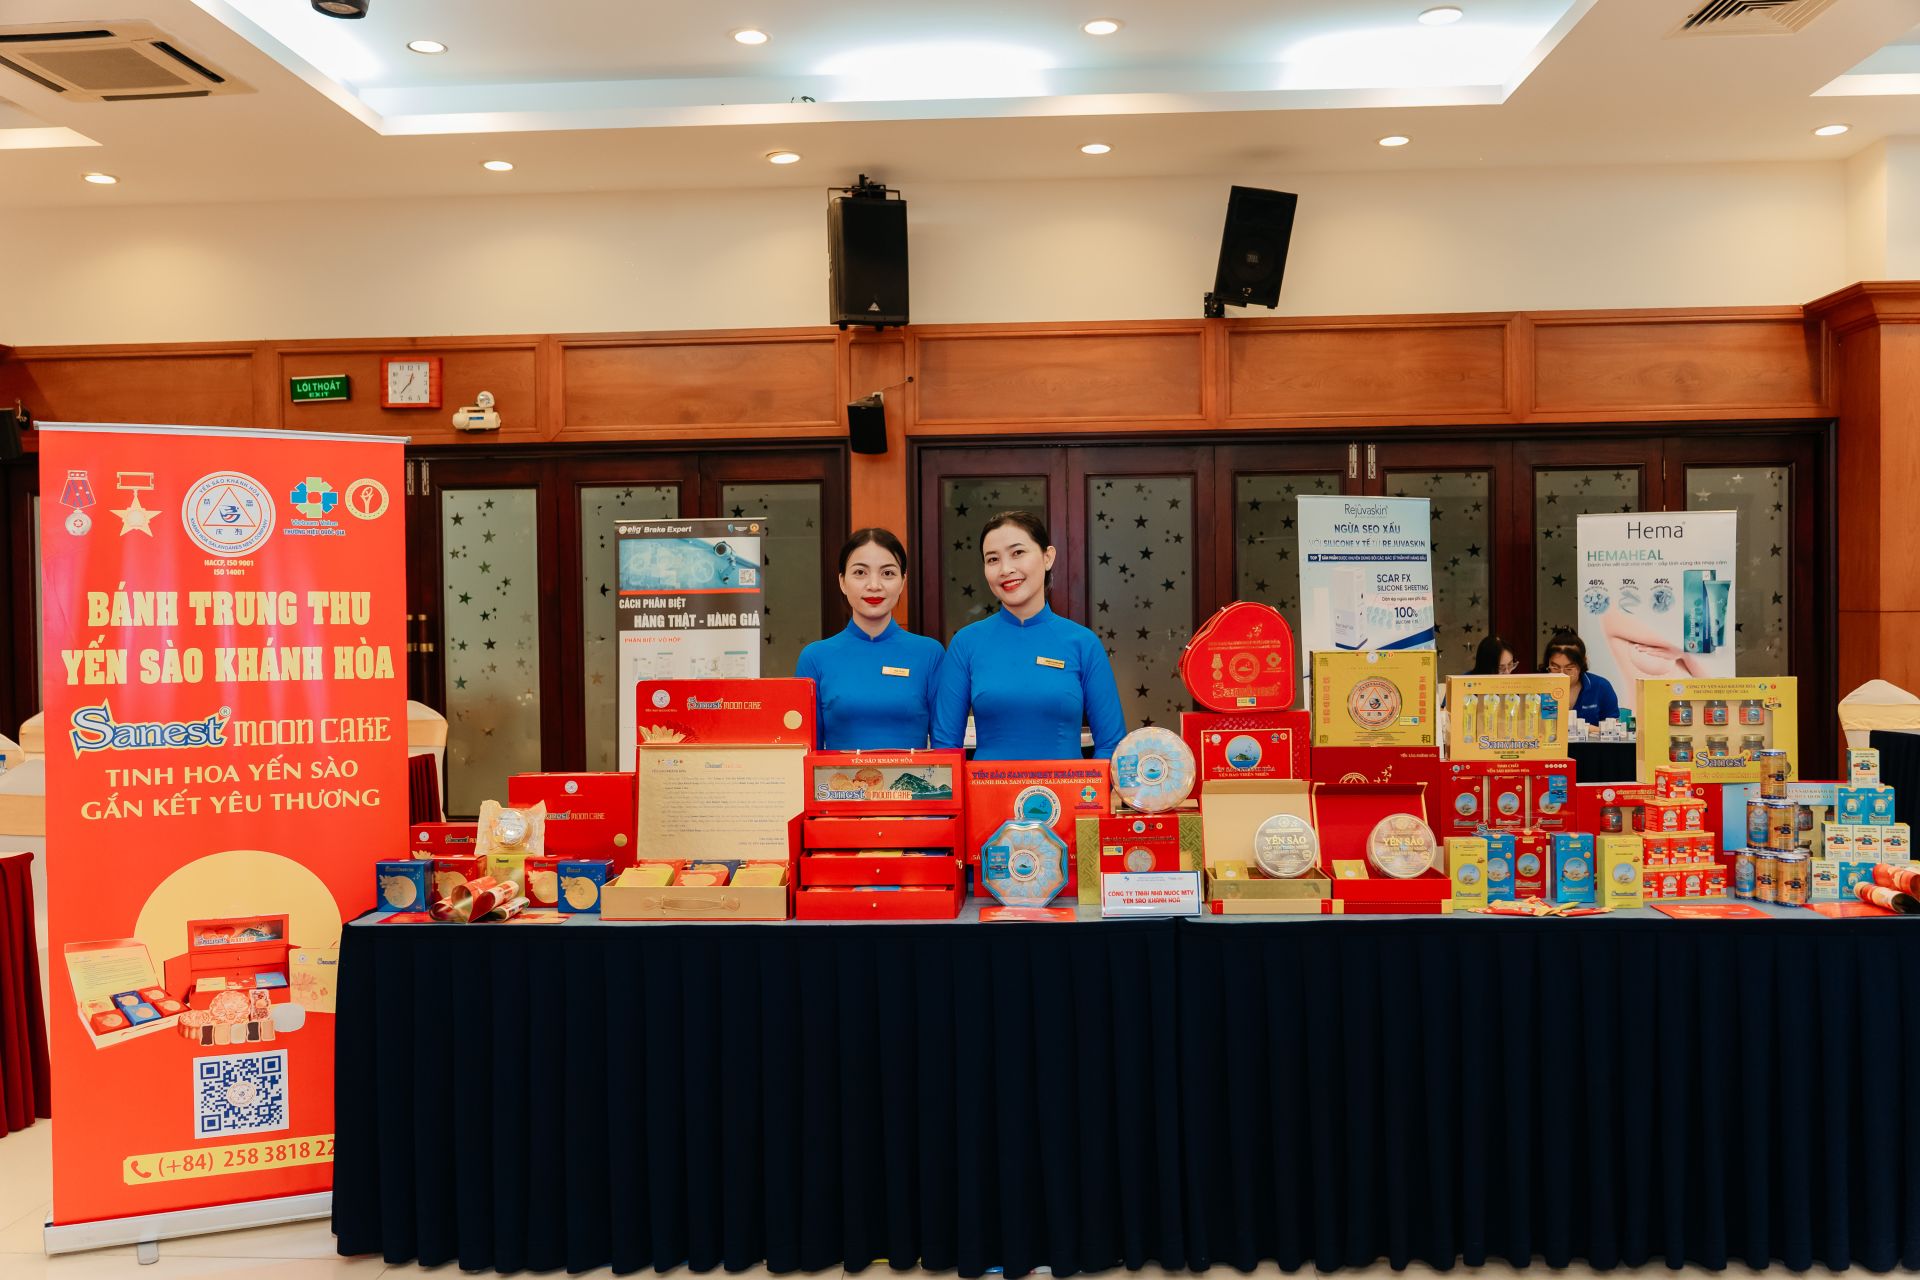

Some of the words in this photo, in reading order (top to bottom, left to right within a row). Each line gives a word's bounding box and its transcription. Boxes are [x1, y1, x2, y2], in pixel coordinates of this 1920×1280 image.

[312, 380, 340, 392] THOÁT
[1334, 522, 1359, 534] NGỪA
[1382, 522, 1400, 534] XẤU
[1627, 522, 1683, 539] Hema
[1587, 550, 1663, 562] HEMAHEAL
[1376, 574, 1399, 583] SCAR
[1401, 574, 1411, 582] FX
[87, 581, 178, 626] BÁNH
[188, 591, 298, 626] TRUNG
[308, 591, 371, 625] THU
[619, 598, 640, 609] CÁCH
[643, 596, 666, 608] PHÂN
[669, 596, 686, 610] BIỆT
[634, 613, 665, 628] HÀNG
[668, 612, 696, 630] THẬT
[707, 612, 737, 627] HÀNG
[740, 610, 760, 626] GIẢ
[62, 634, 128, 685] YẾN
[140, 640, 204, 684] SÀO
[214, 637, 323, 682] KHÁNH
[333, 637, 395, 680] HÒA
[71, 702, 226, 753] Sanest
[233, 719, 314, 746] MOON
[320, 716, 392, 744] CAKE
[1479, 736, 1540, 749] Sanvinest
[1696, 752, 1746, 768] Sanest
[105, 767, 174, 787] TINH
[184, 765, 240, 784] HOA
[248, 754, 302, 782] YẾN
[310, 756, 360, 779] SÀO
[817, 784, 865, 800] Sanest
[80, 792, 142, 820] GẮN
[152, 789, 202, 816] KẾT
[210, 790, 262, 814] YÊU
[270, 788, 380, 811] THƯƠNG
[1288, 835, 1306, 844] SÀO
[158, 1152, 214, 1178] (+84)
[223, 1147, 259, 1168] 258
[264, 1141, 311, 1162] 3818
